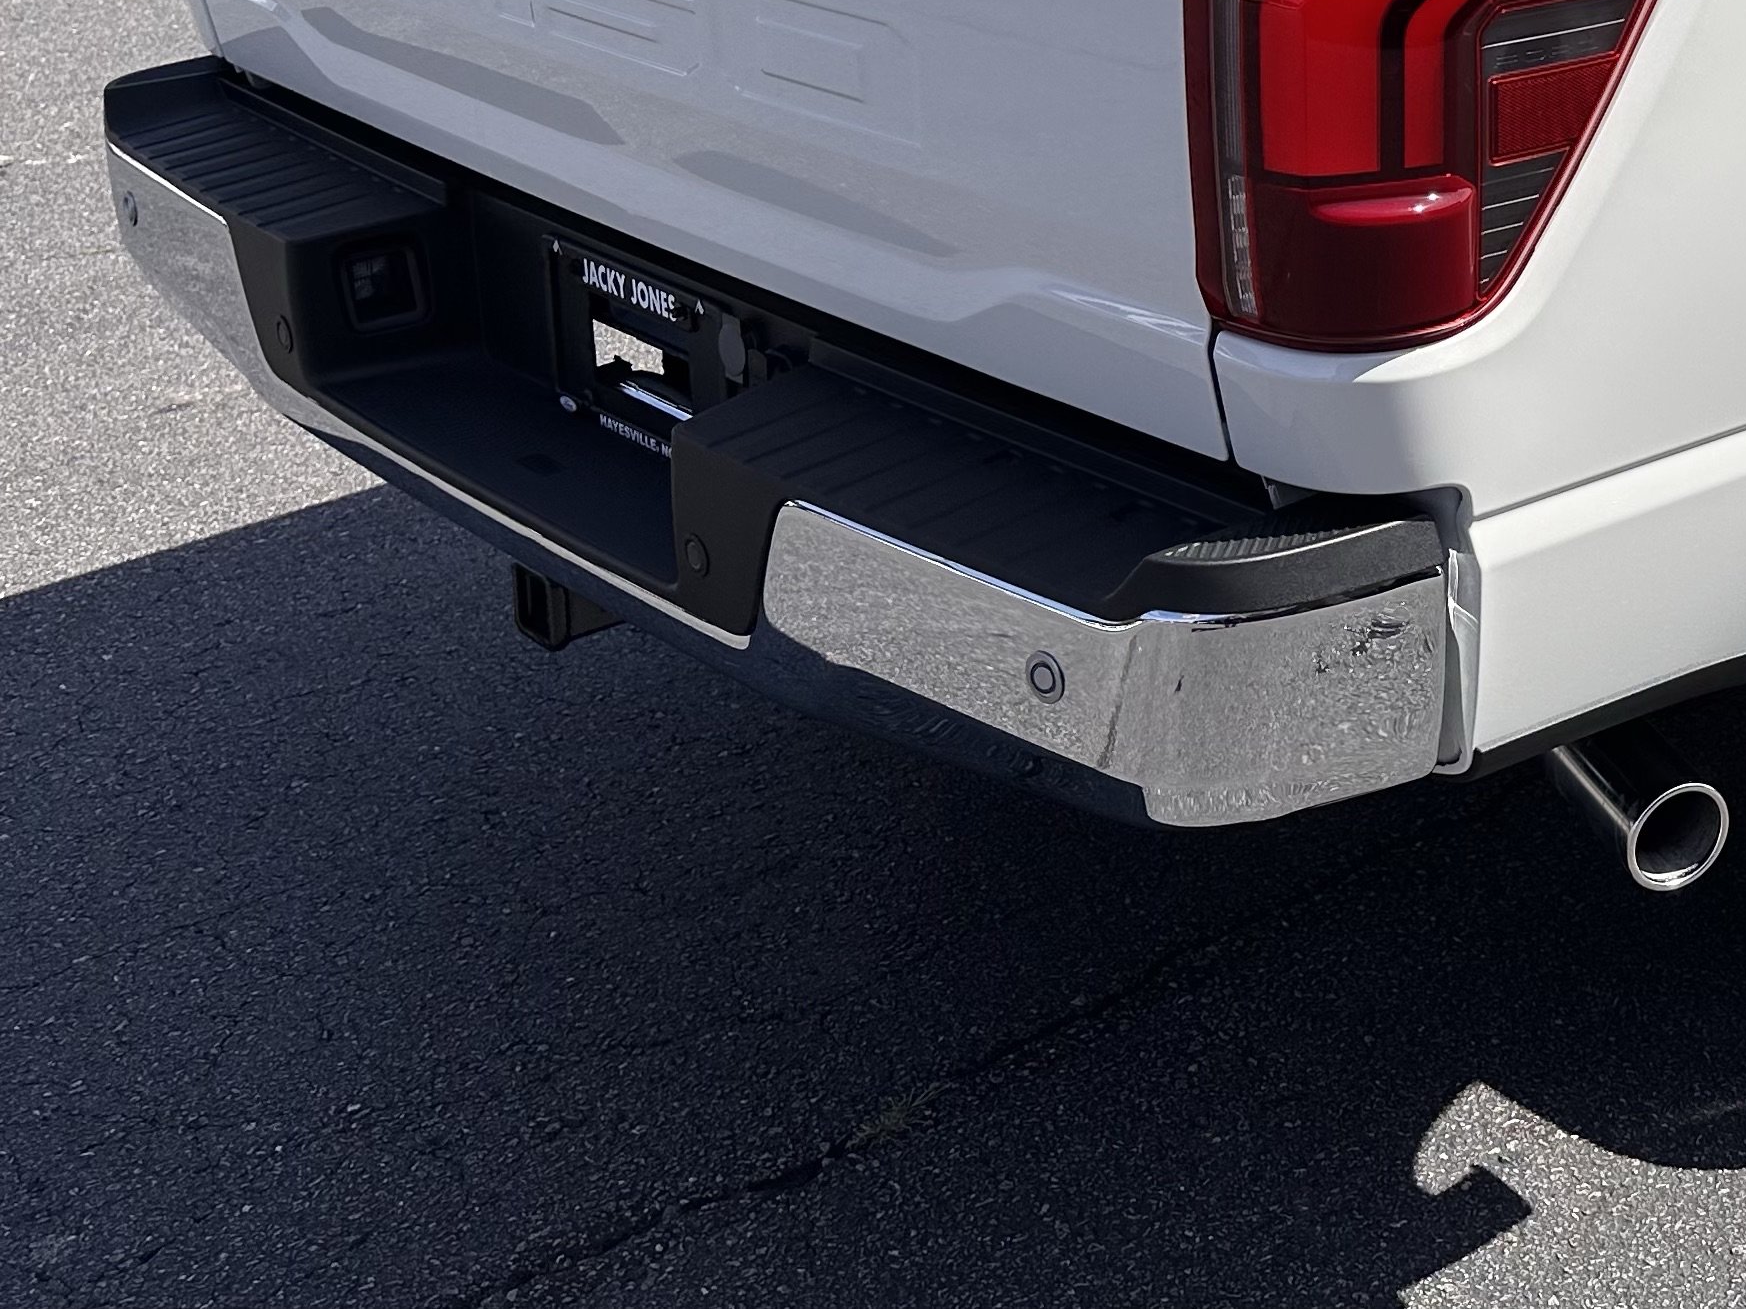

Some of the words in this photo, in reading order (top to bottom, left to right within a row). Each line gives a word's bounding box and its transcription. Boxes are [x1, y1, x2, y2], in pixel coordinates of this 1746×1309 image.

[582, 257, 626, 299] JACKY
[630, 278, 678, 322] JONES
[600, 413, 659, 453] HAYESVILLE,
